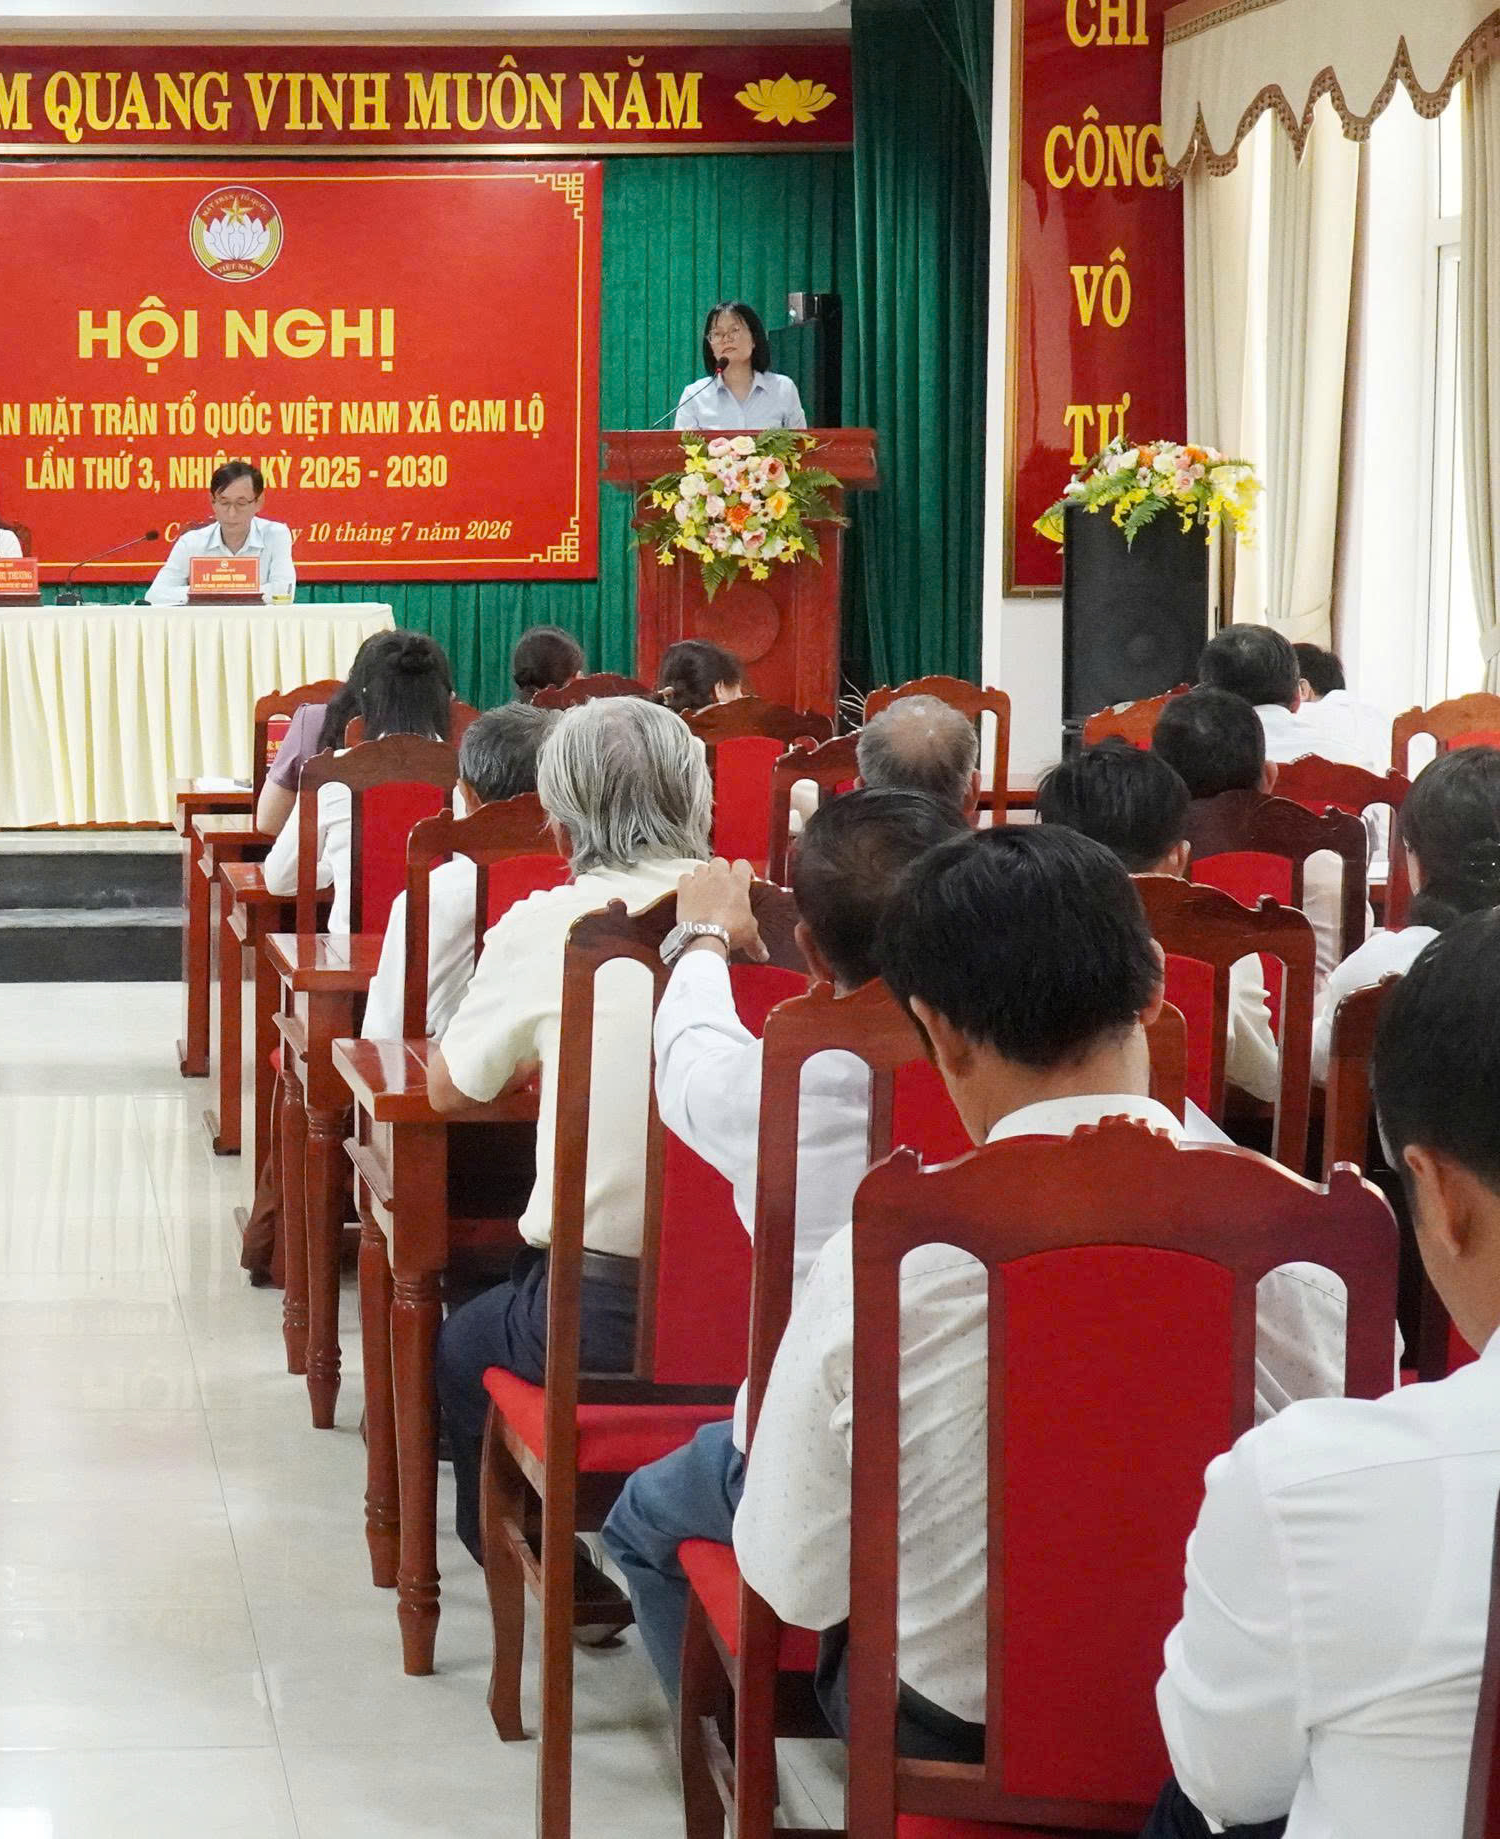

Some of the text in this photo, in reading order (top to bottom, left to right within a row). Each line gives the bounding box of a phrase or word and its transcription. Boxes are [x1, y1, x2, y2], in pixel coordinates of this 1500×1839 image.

[44, 70, 232, 144] QUANG
[244, 72, 390, 131] VINH
[404, 55, 566, 131] MUÔN
[579, 55, 703, 131] NĂM
[1044, 104, 1164, 188] CÔNG
[1070, 247, 1132, 328] VÔ
[78, 296, 395, 373] HỘI NGHỊ
[30, 397, 83, 443] MẶT
[91, 396, 158, 443] TRẬN
[165, 389, 197, 436] TỔ
[204, 390, 272, 439] QUỐC
[280, 395, 333, 442] VIỆT
[341, 401, 400, 435] NAM
[408, 393, 442, 434] XÃ
[450, 400, 506, 434] CAM
[514, 393, 545, 439] LỘ
[26, 446, 448, 494] LẦN THỨ 3, NHI KỲ 2025 - 2030
[307, 522, 331, 543] 10
[336, 521, 397, 546] tháng
[401, 522, 413, 543] 7
[416, 521, 463, 542] năm
[466, 519, 512, 540] 2026
